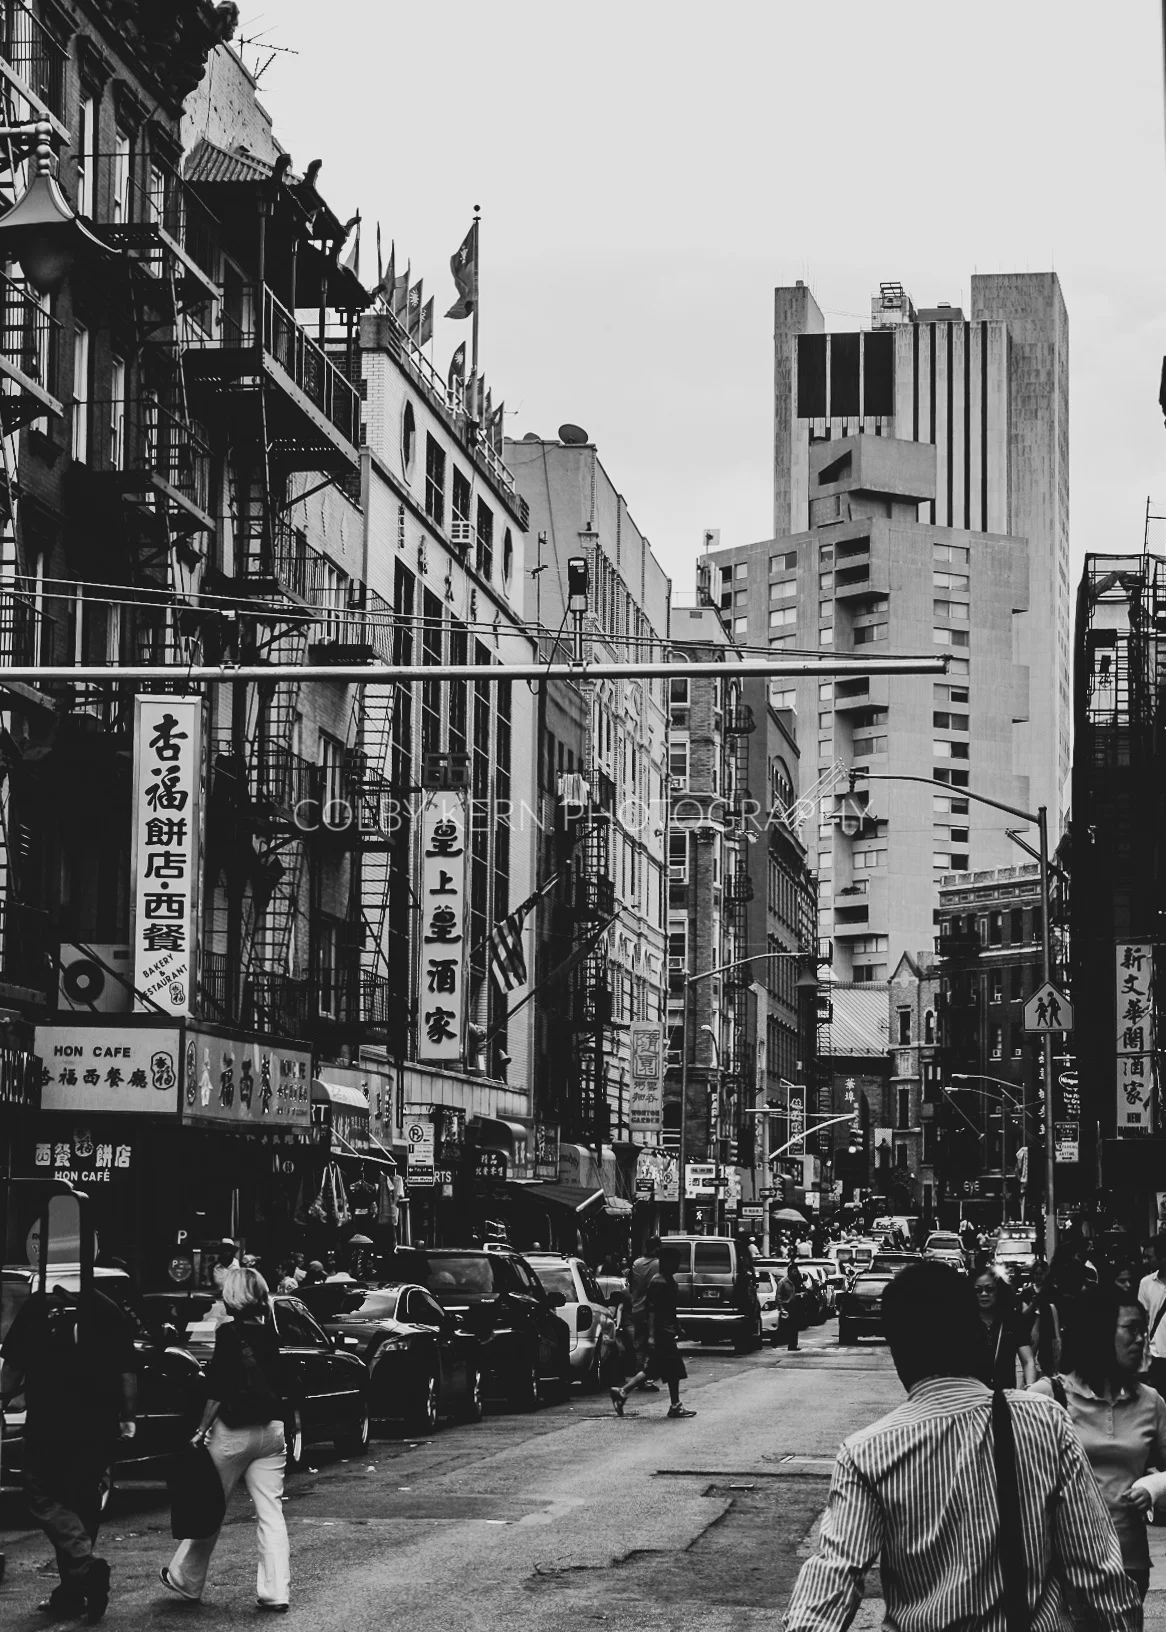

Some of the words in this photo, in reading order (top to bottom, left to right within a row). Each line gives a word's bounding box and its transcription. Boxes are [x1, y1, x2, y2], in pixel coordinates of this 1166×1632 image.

[424, 818, 464, 1044] 皇上皇酒家
[142, 953, 174, 979] BAKERY
[143, 964, 188, 999] ESTAURANT
[54, 1046, 83, 1057] HON
[93, 1046, 131, 1058] CAFE
[35, 1142, 71, 1167] 西餐
[95, 1143, 131, 1168] 餅店
[54, 1170, 78, 1181] HON
[81, 1168, 110, 1181] CAFÉ
